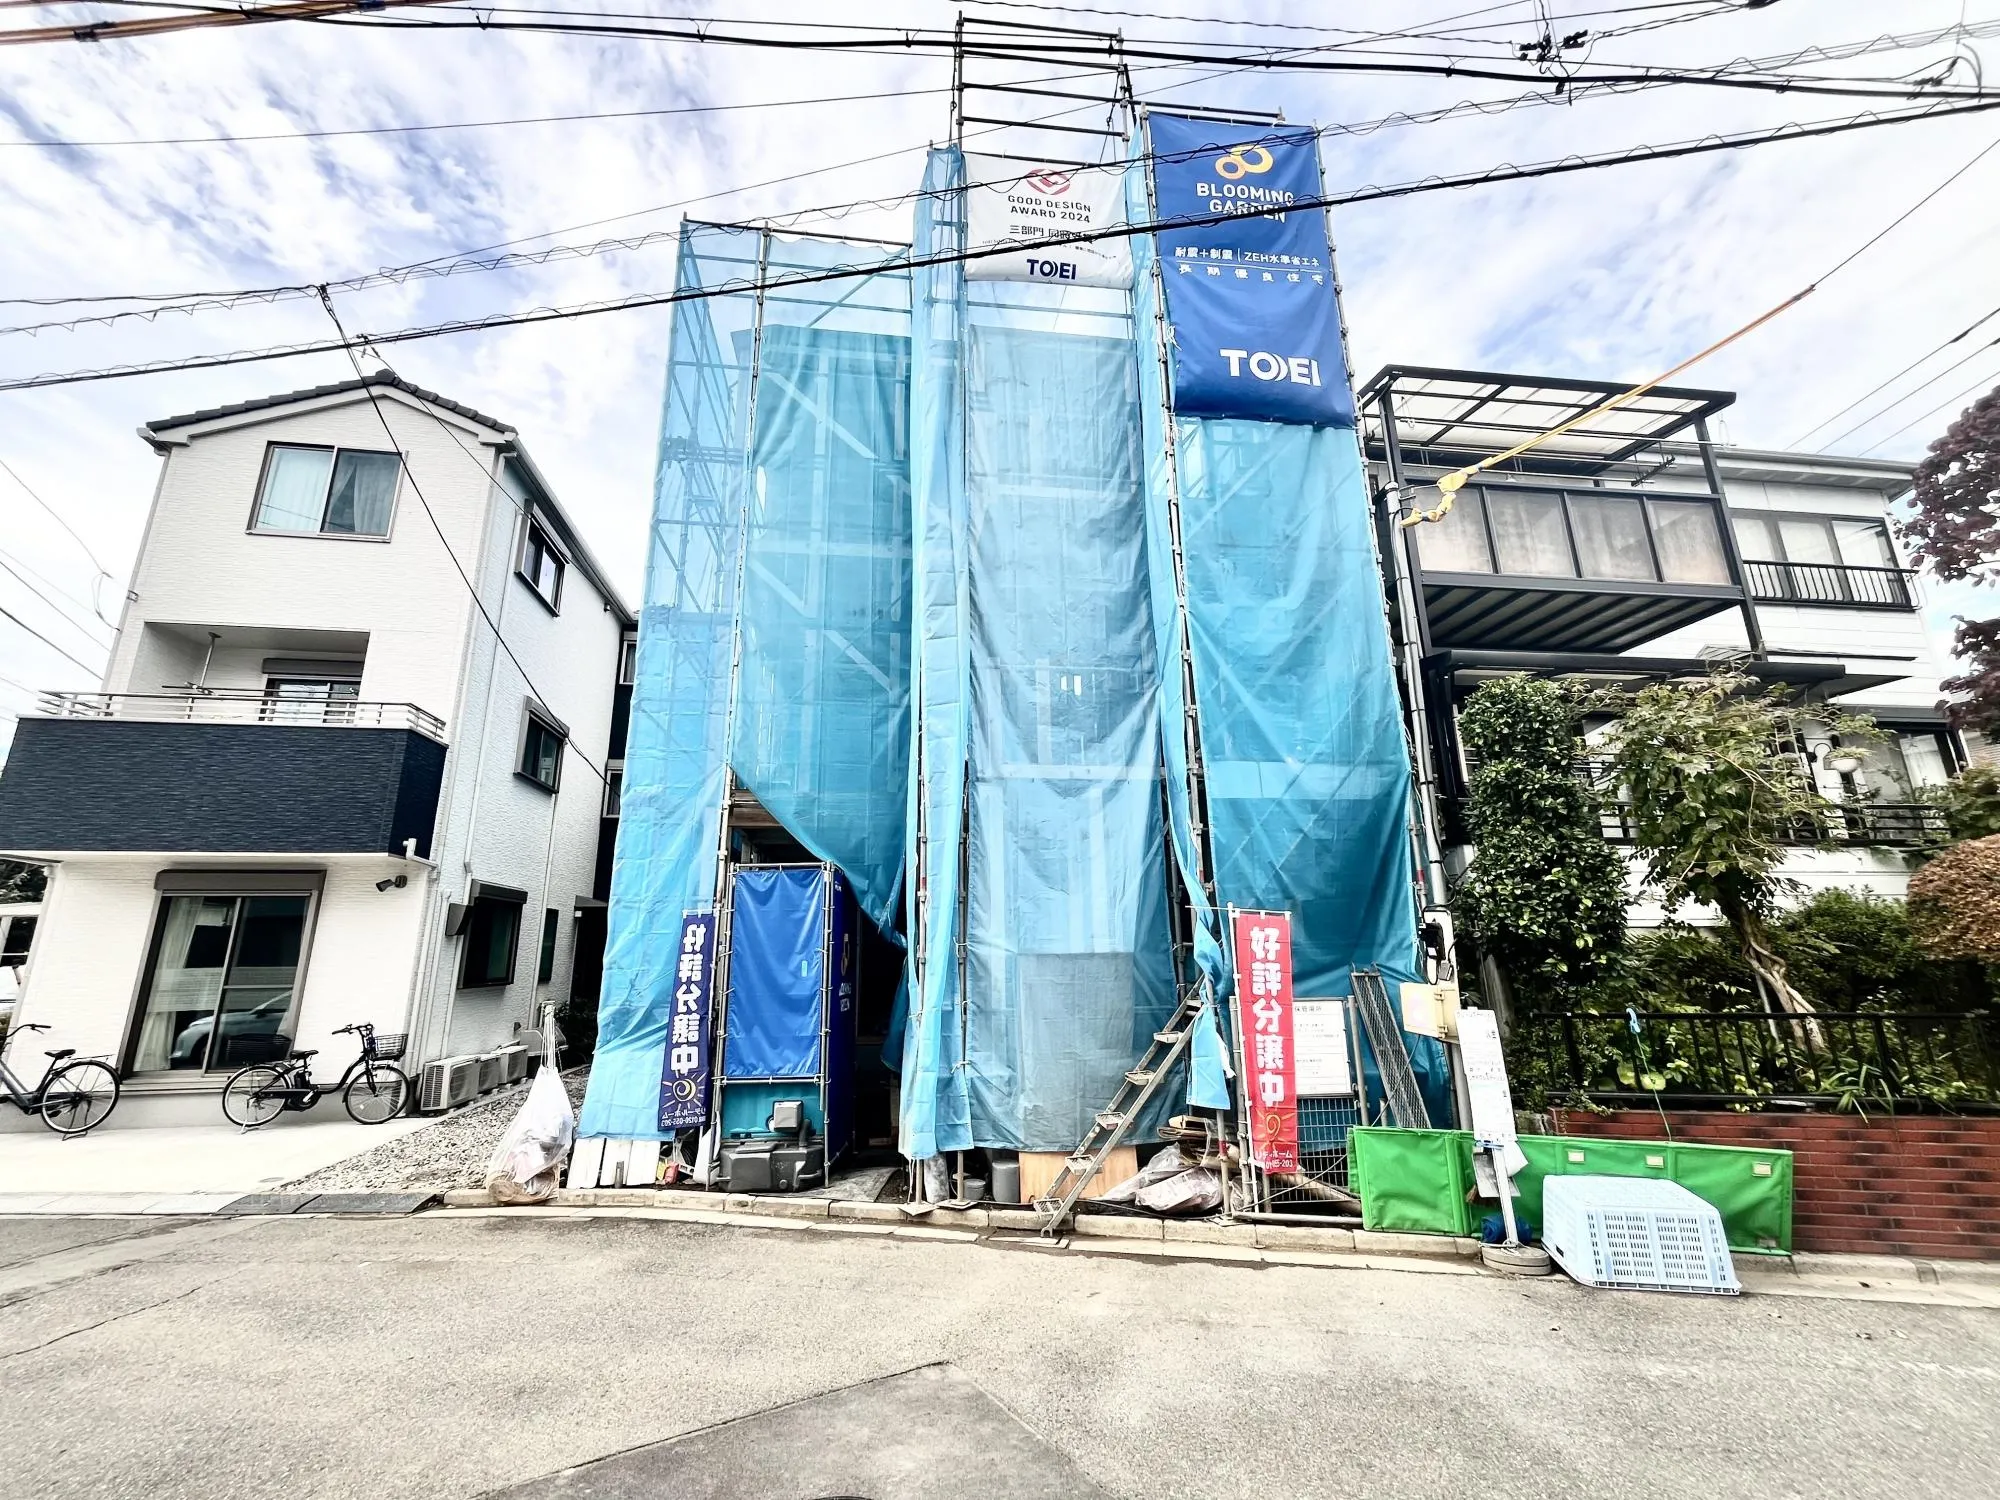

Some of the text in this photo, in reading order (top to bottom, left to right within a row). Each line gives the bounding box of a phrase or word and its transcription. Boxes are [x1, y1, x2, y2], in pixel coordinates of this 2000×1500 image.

[1007, 194, 1091, 212] GOOD DESIGN
[1196, 182, 1294, 206] BLOOMING
[1010, 205, 1091, 223] AWARD 2024
[1009, 224, 1044, 237] 三部門
[1250, 925, 1285, 1108] 好評分譲中
